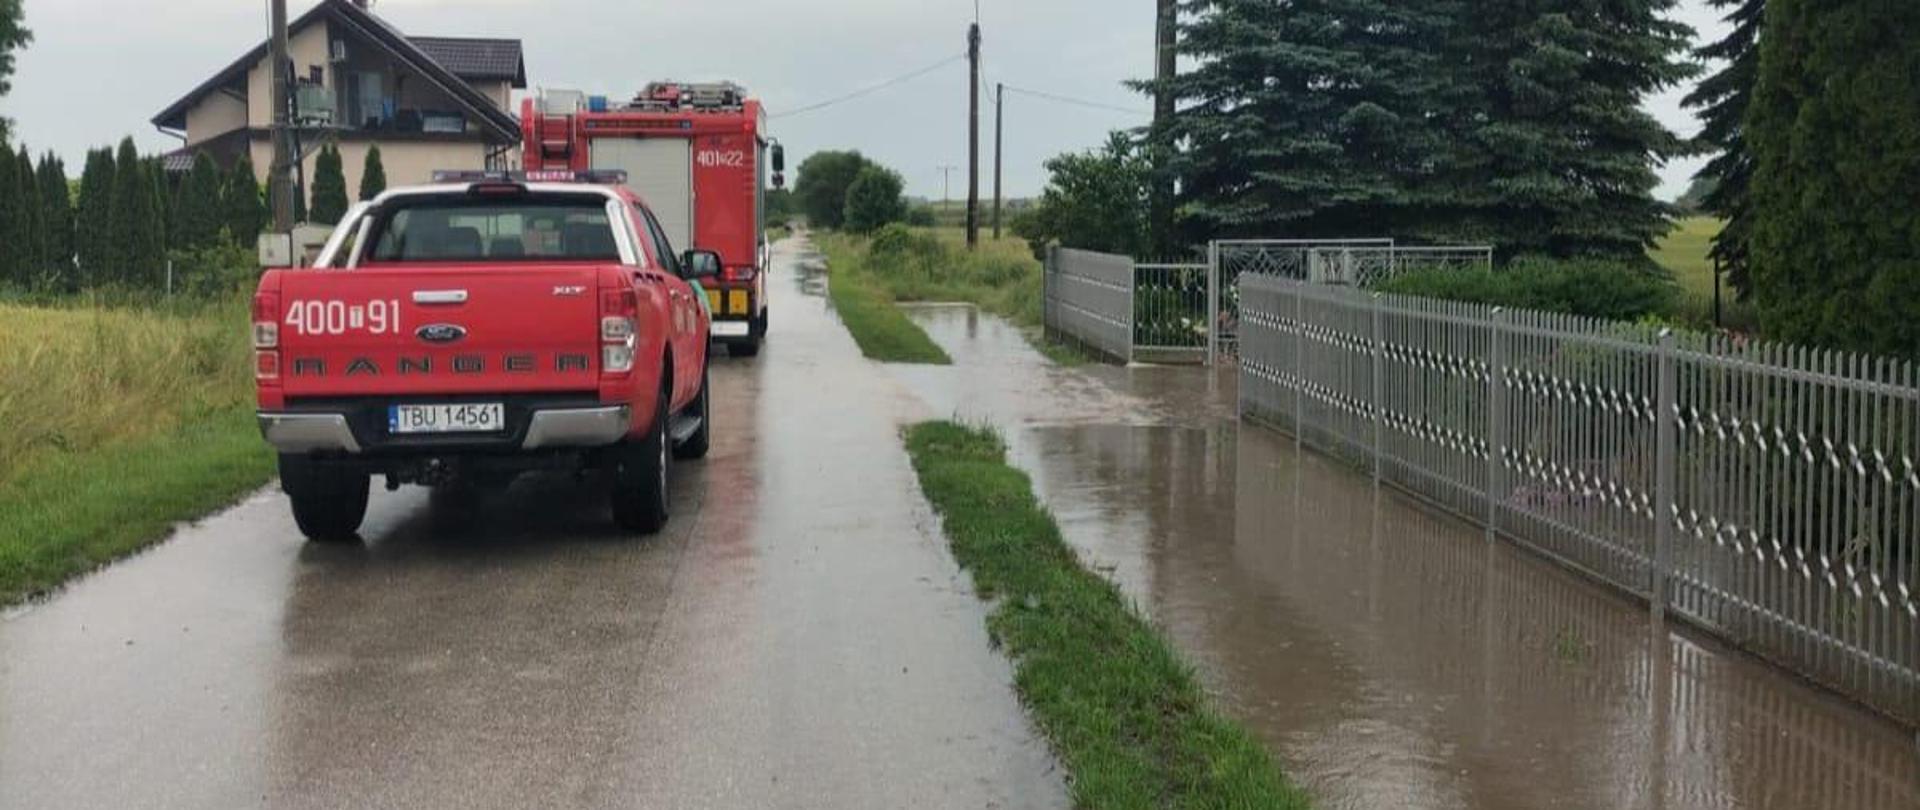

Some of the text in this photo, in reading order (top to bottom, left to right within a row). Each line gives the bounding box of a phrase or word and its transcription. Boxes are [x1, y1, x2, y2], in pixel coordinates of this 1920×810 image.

[294, 353, 589, 376] RANGER
[401, 403, 500, 426] TBU 14561
